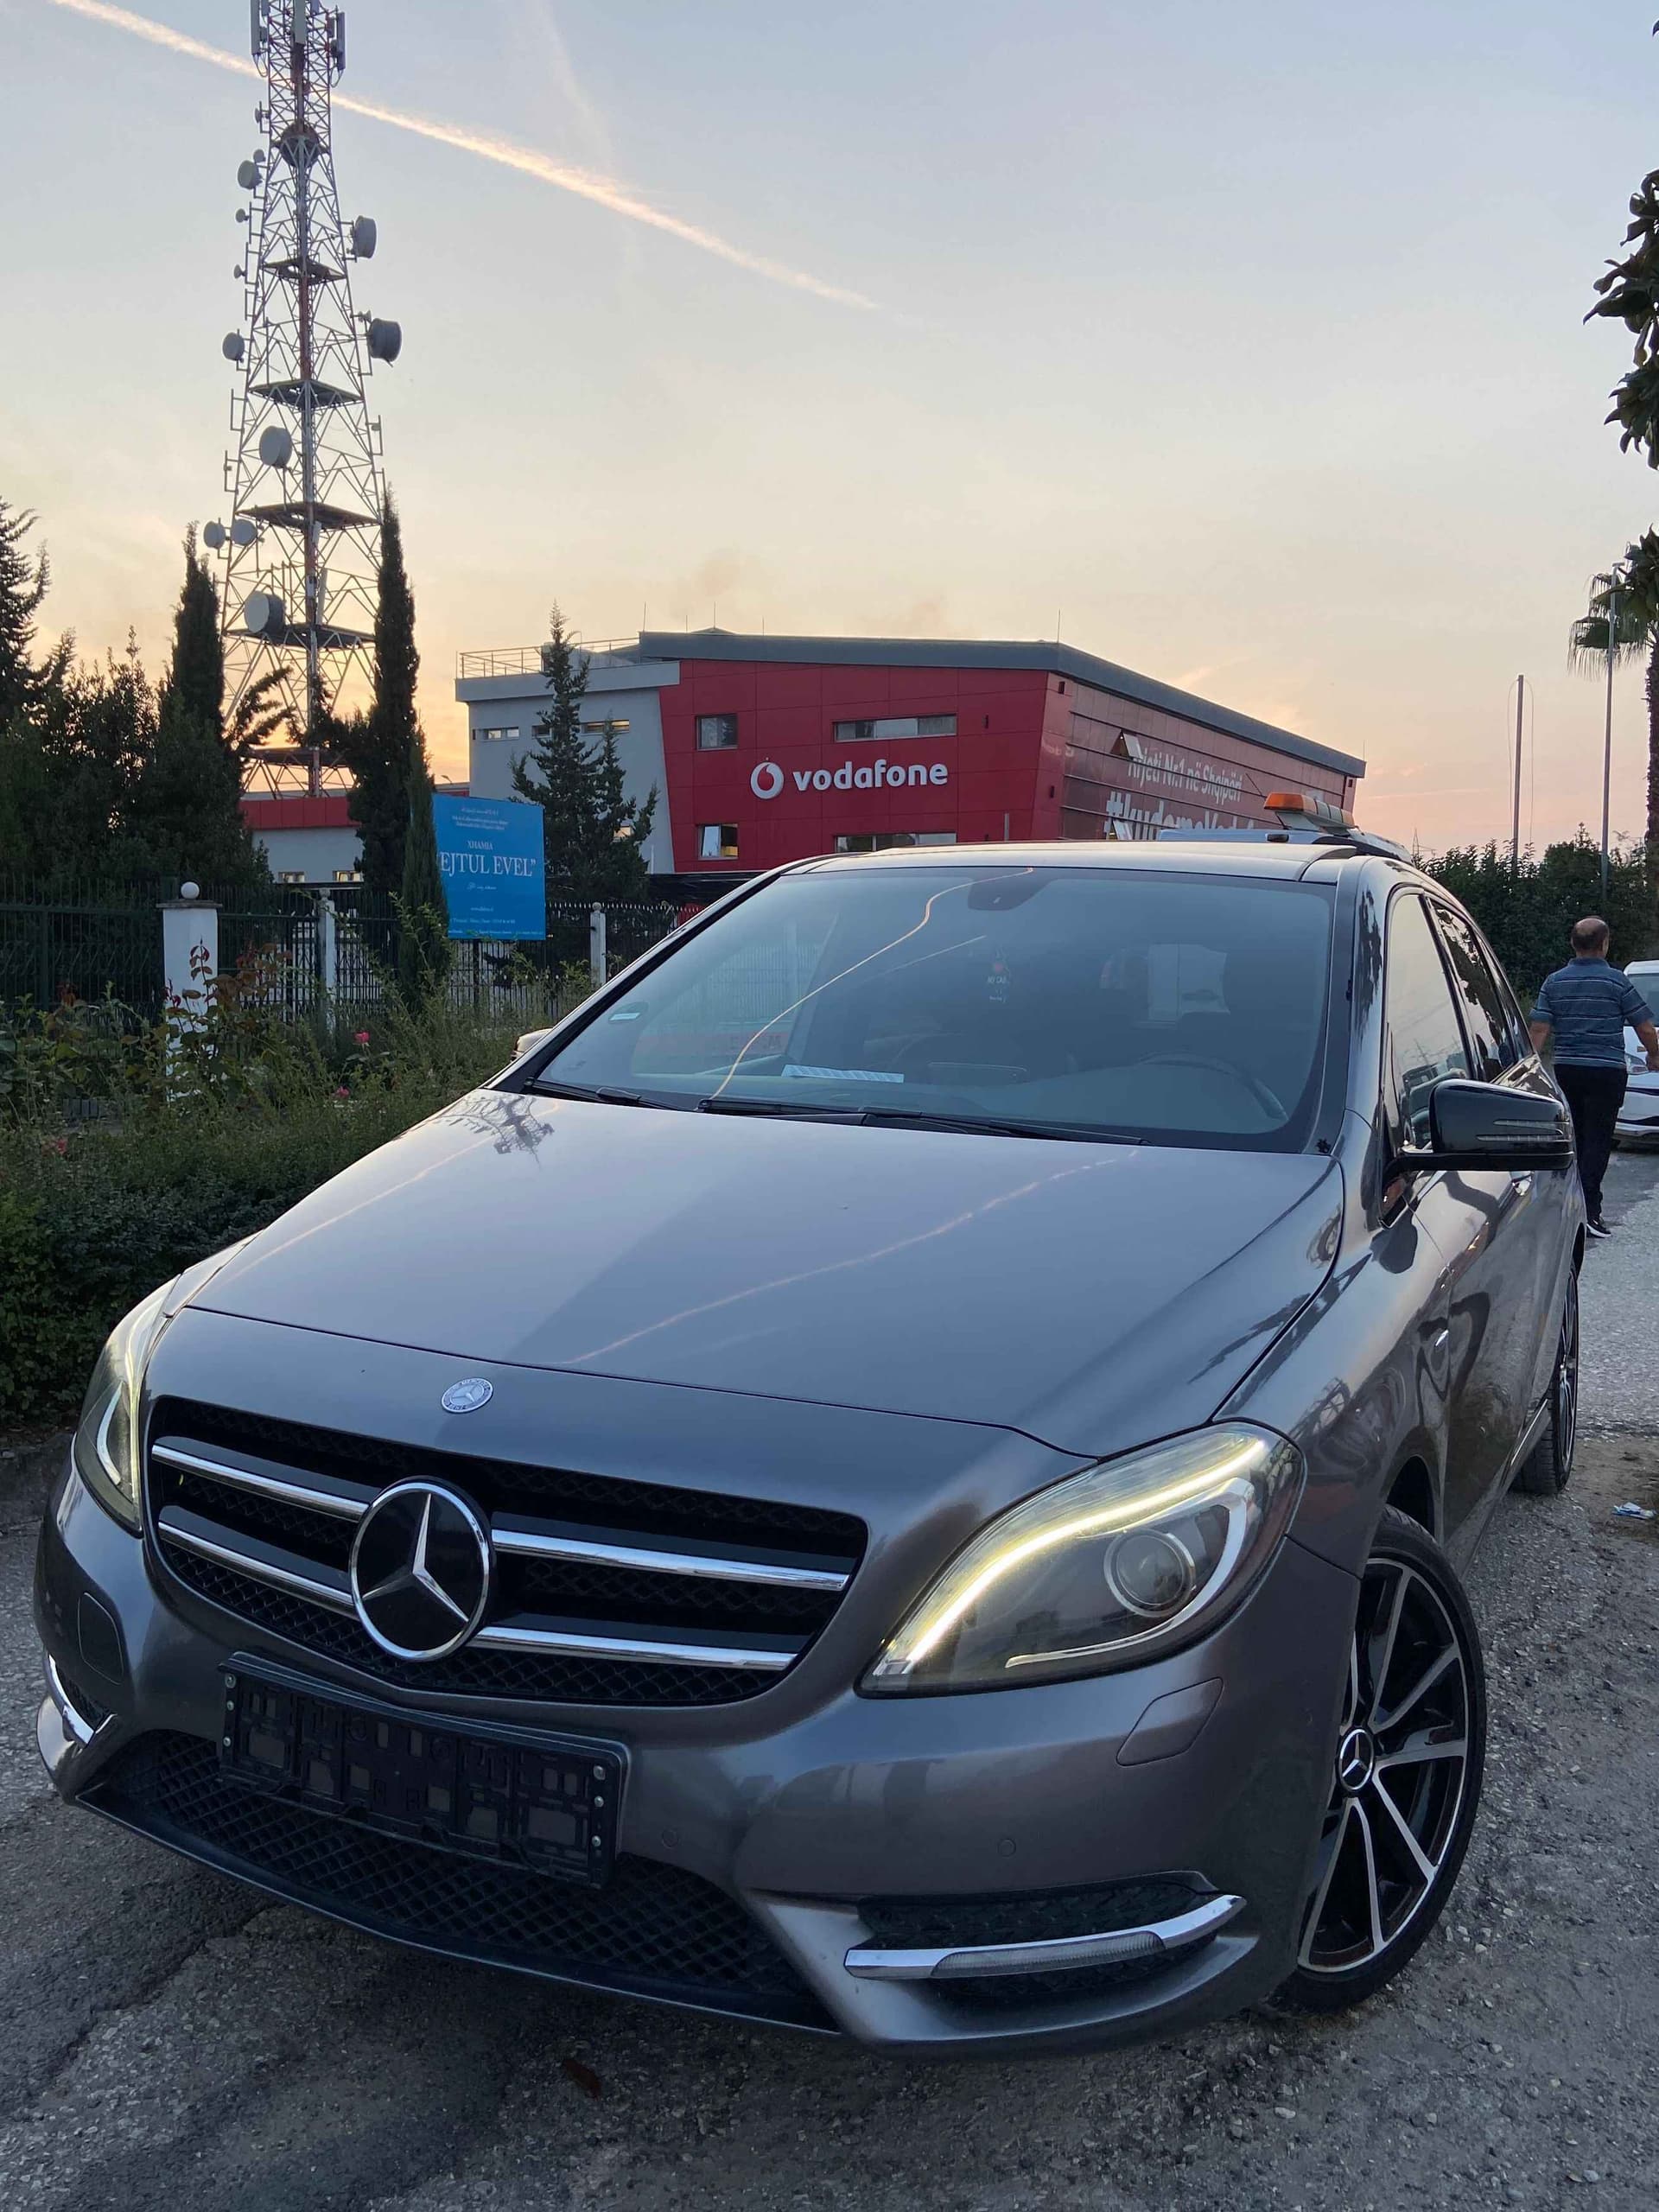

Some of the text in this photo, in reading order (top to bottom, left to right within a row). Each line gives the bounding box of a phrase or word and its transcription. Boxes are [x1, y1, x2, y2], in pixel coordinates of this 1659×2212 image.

[792, 759, 948, 791] vodafone
[1185, 761, 1201, 792] në
[1201, 764, 1243, 805] Shqipëri
[437, 851, 489, 877] EJTUL
